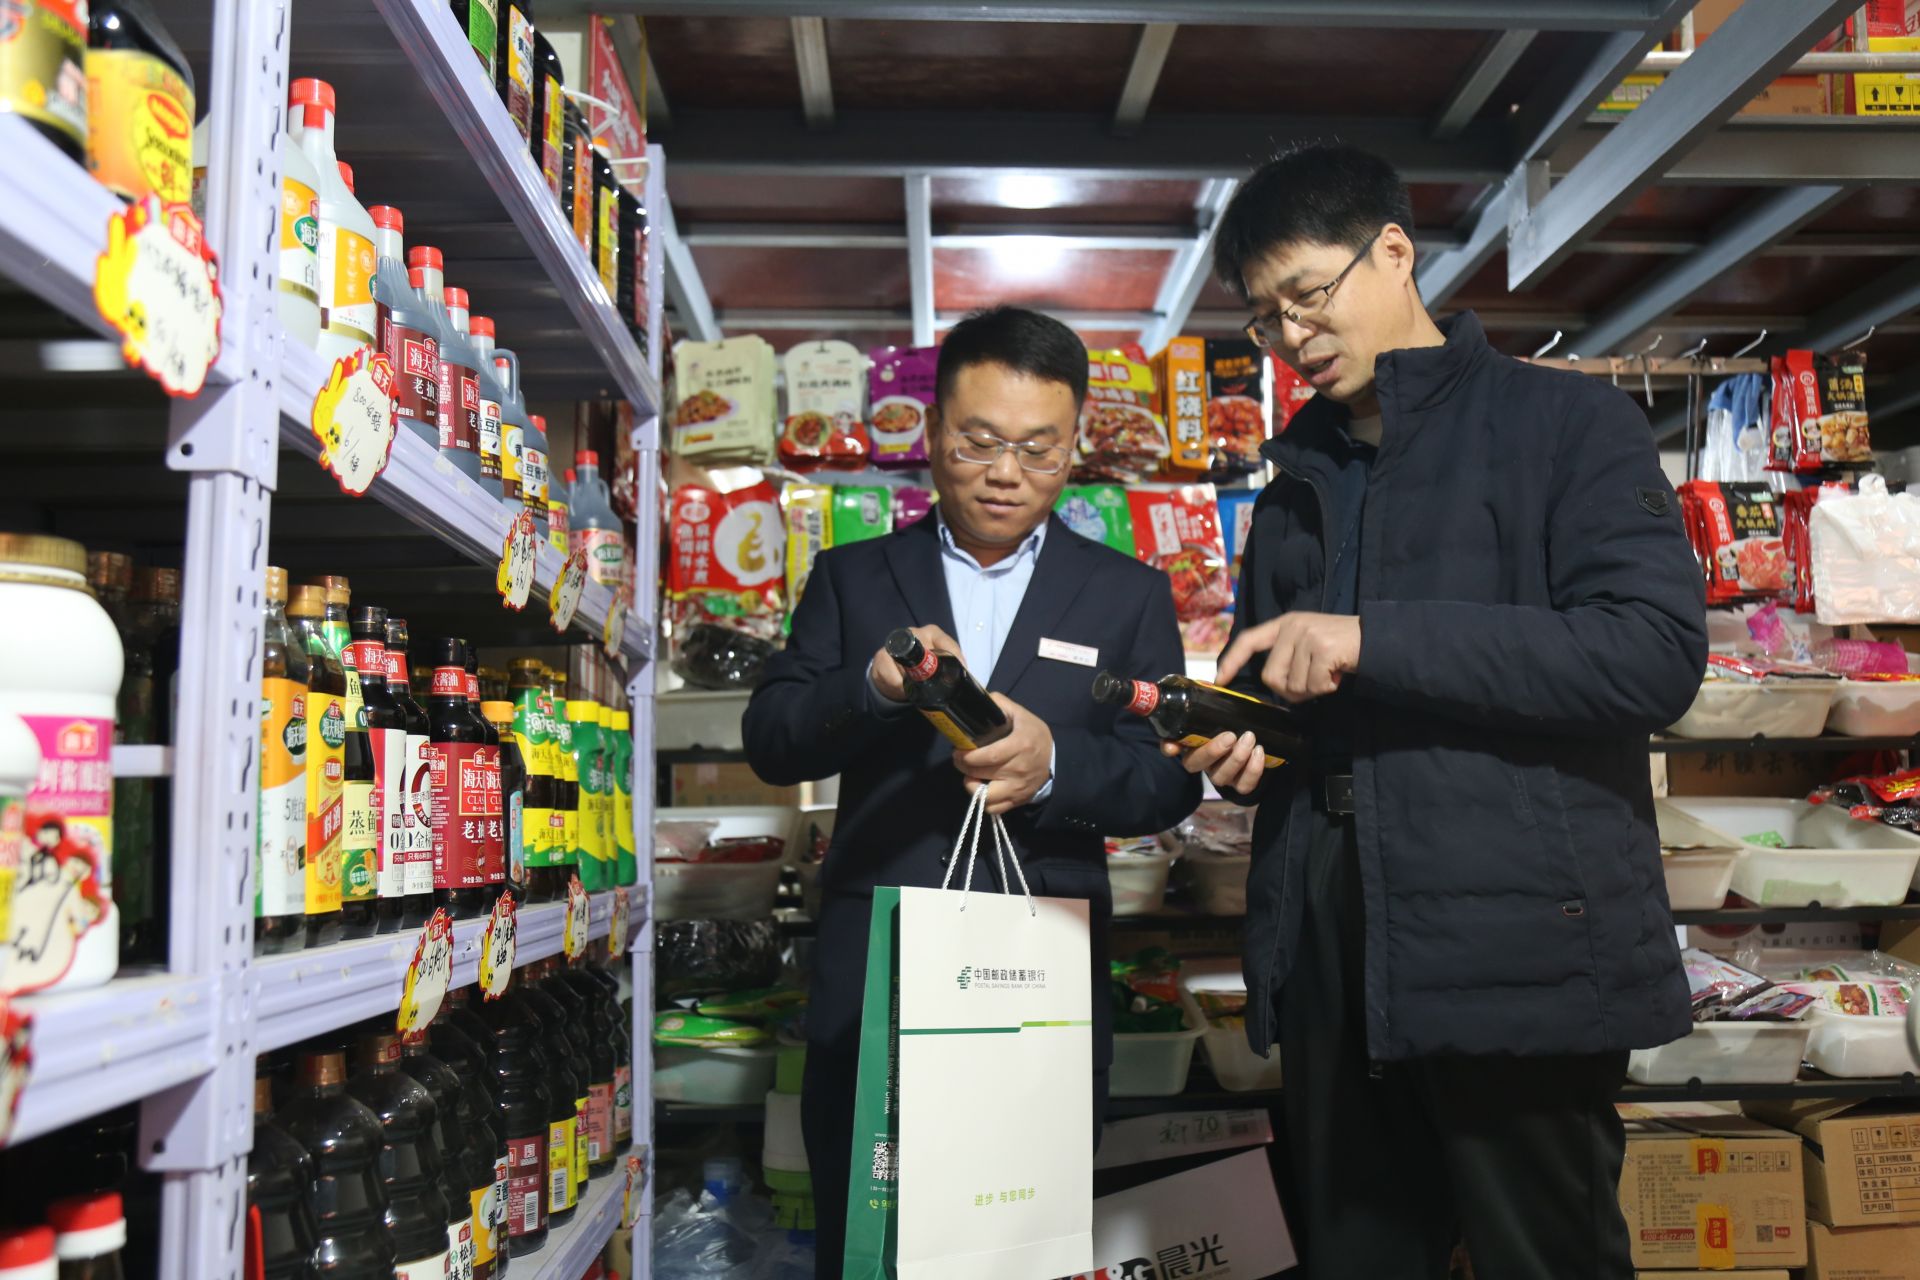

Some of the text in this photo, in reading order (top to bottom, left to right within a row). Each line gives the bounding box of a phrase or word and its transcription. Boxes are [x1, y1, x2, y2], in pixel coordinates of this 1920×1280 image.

[974, 968, 1045, 982] 中国邮政储蓄银行
[1864, 1203, 1891, 1212] 生产日期
[1156, 1233, 1229, 1280] 晨光
